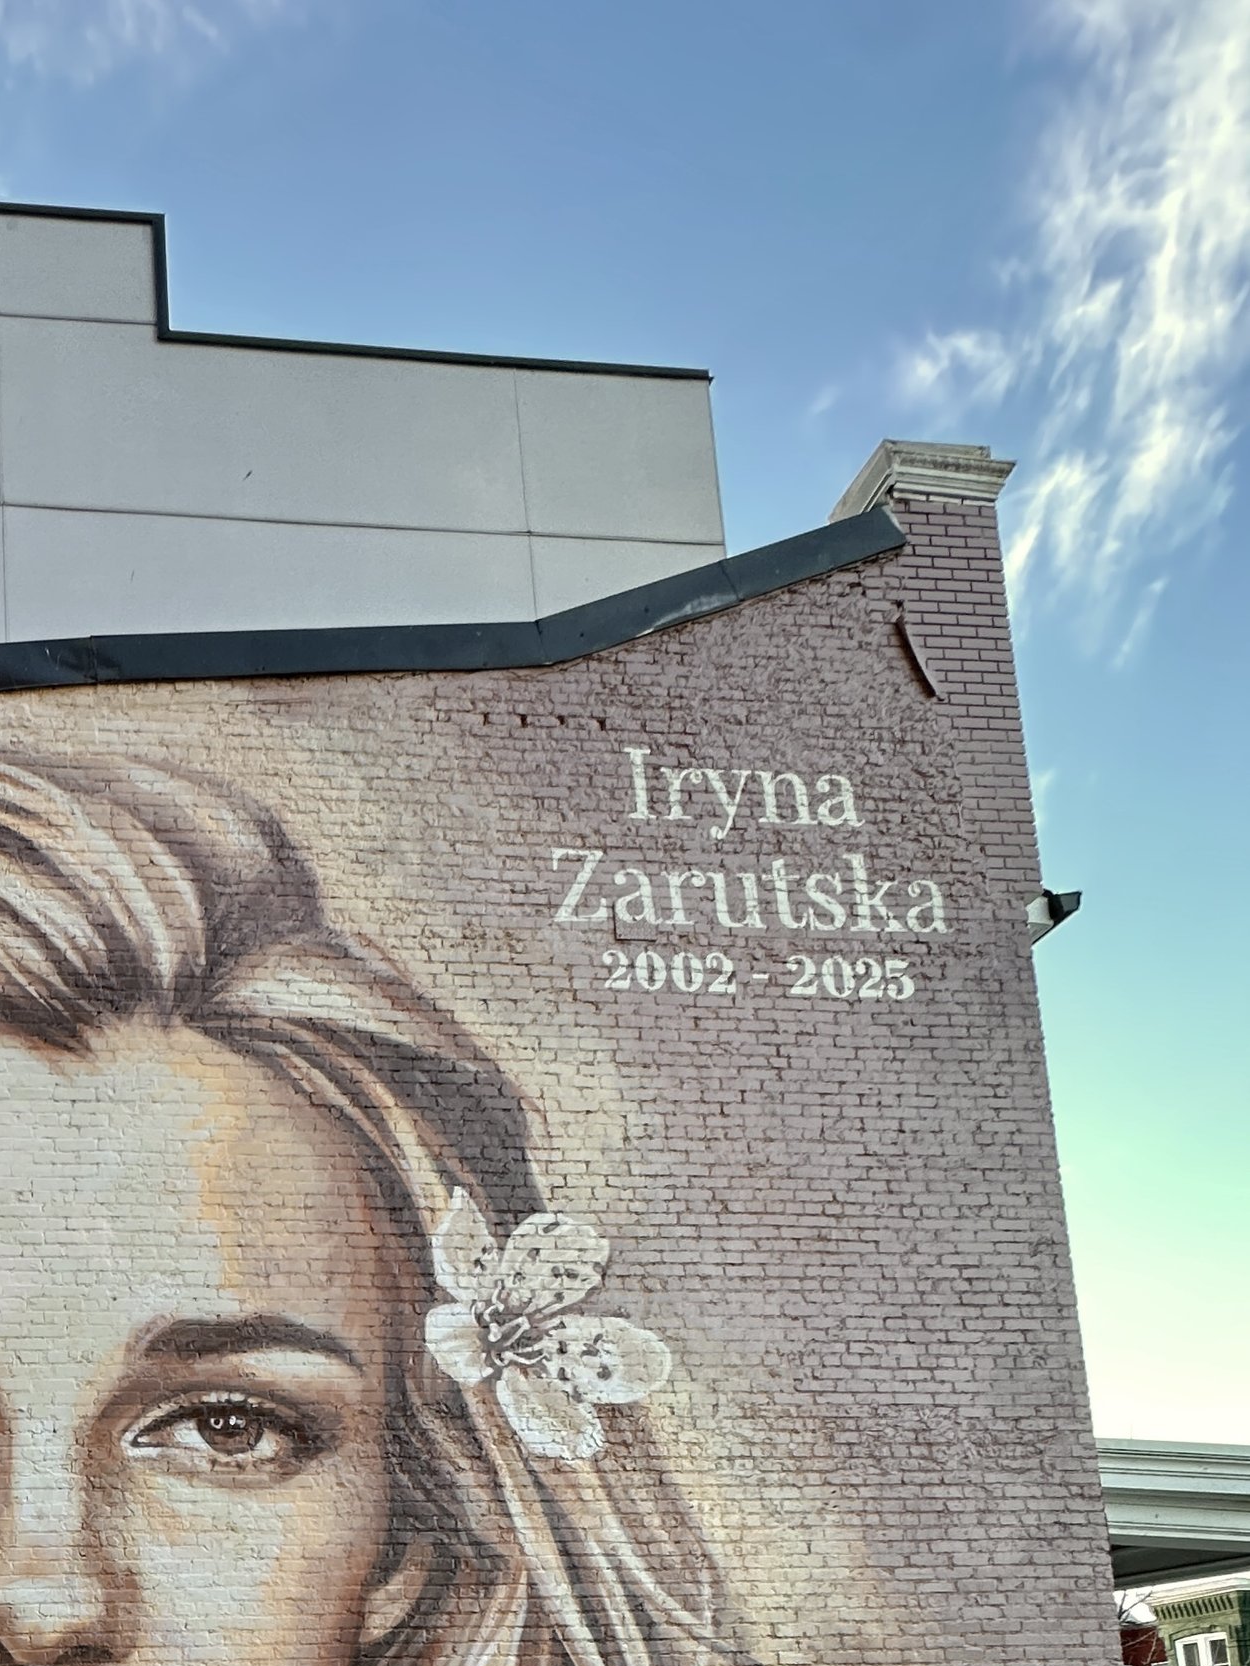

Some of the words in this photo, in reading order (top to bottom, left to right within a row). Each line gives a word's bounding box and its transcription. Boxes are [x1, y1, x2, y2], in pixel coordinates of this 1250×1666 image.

[623, 746, 866, 840] Iryna
[550, 847, 954, 934] Zarutska
[602, 949, 738, 994] 2002
[787, 954, 915, 1000] 2025
